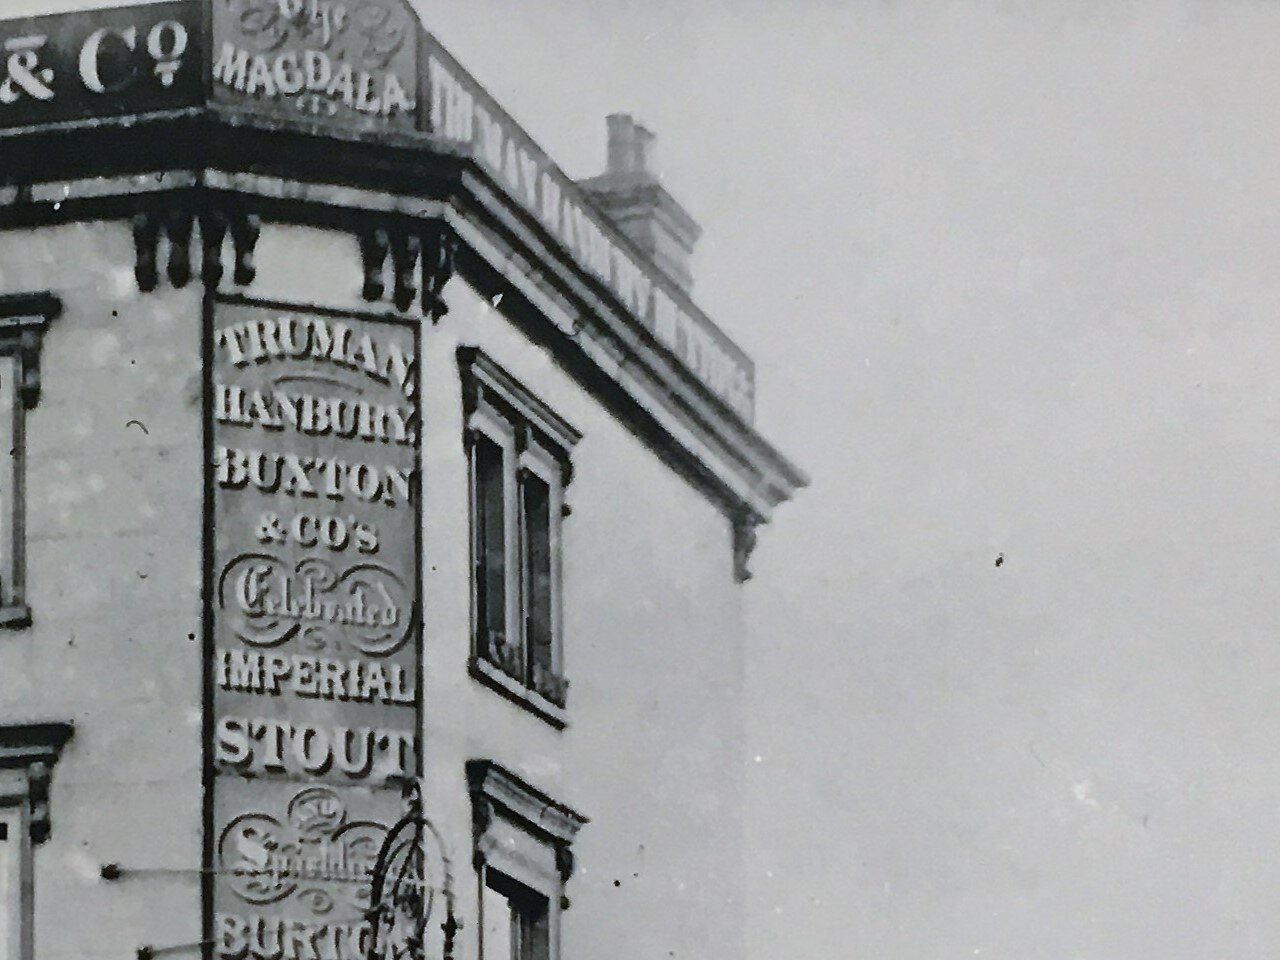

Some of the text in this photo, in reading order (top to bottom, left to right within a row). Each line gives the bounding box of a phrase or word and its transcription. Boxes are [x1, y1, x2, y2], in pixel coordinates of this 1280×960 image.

[213, 42, 415, 114] MAGDALA
[216, 318, 417, 397] TRUMAN
[216, 385, 417, 444] HANBURY
[215, 447, 415, 507] BUXTON
[256, 513, 286, 544] &
[217, 651, 418, 706] IMPERIAL
[216, 716, 417, 778] STOUT
